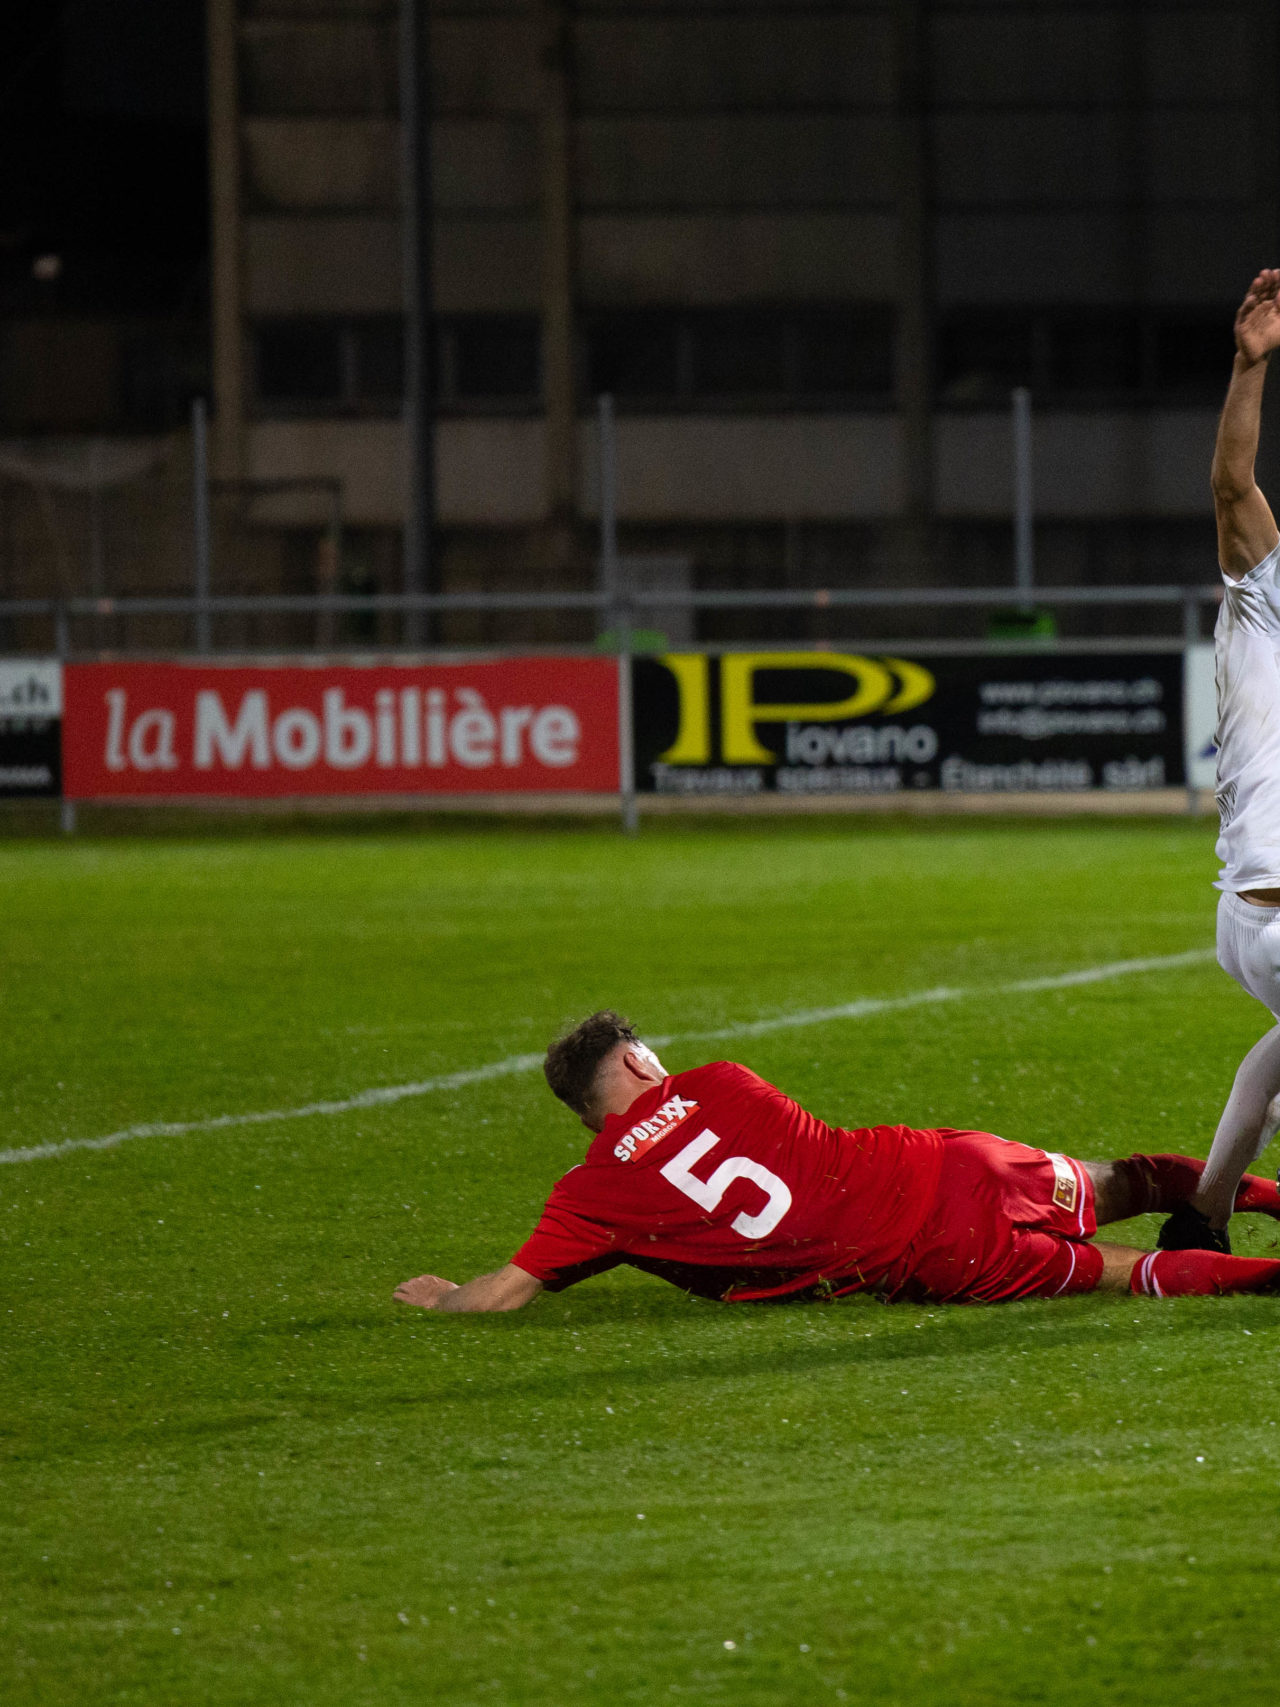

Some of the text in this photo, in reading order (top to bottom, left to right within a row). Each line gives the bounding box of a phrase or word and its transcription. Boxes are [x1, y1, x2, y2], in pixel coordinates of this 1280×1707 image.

[105, 687, 580, 771] la Mobilière
[613, 1094, 698, 1162] SPORTXX
[651, 1121, 678, 1143] MIGROS
[659, 1127, 792, 1240] 5
